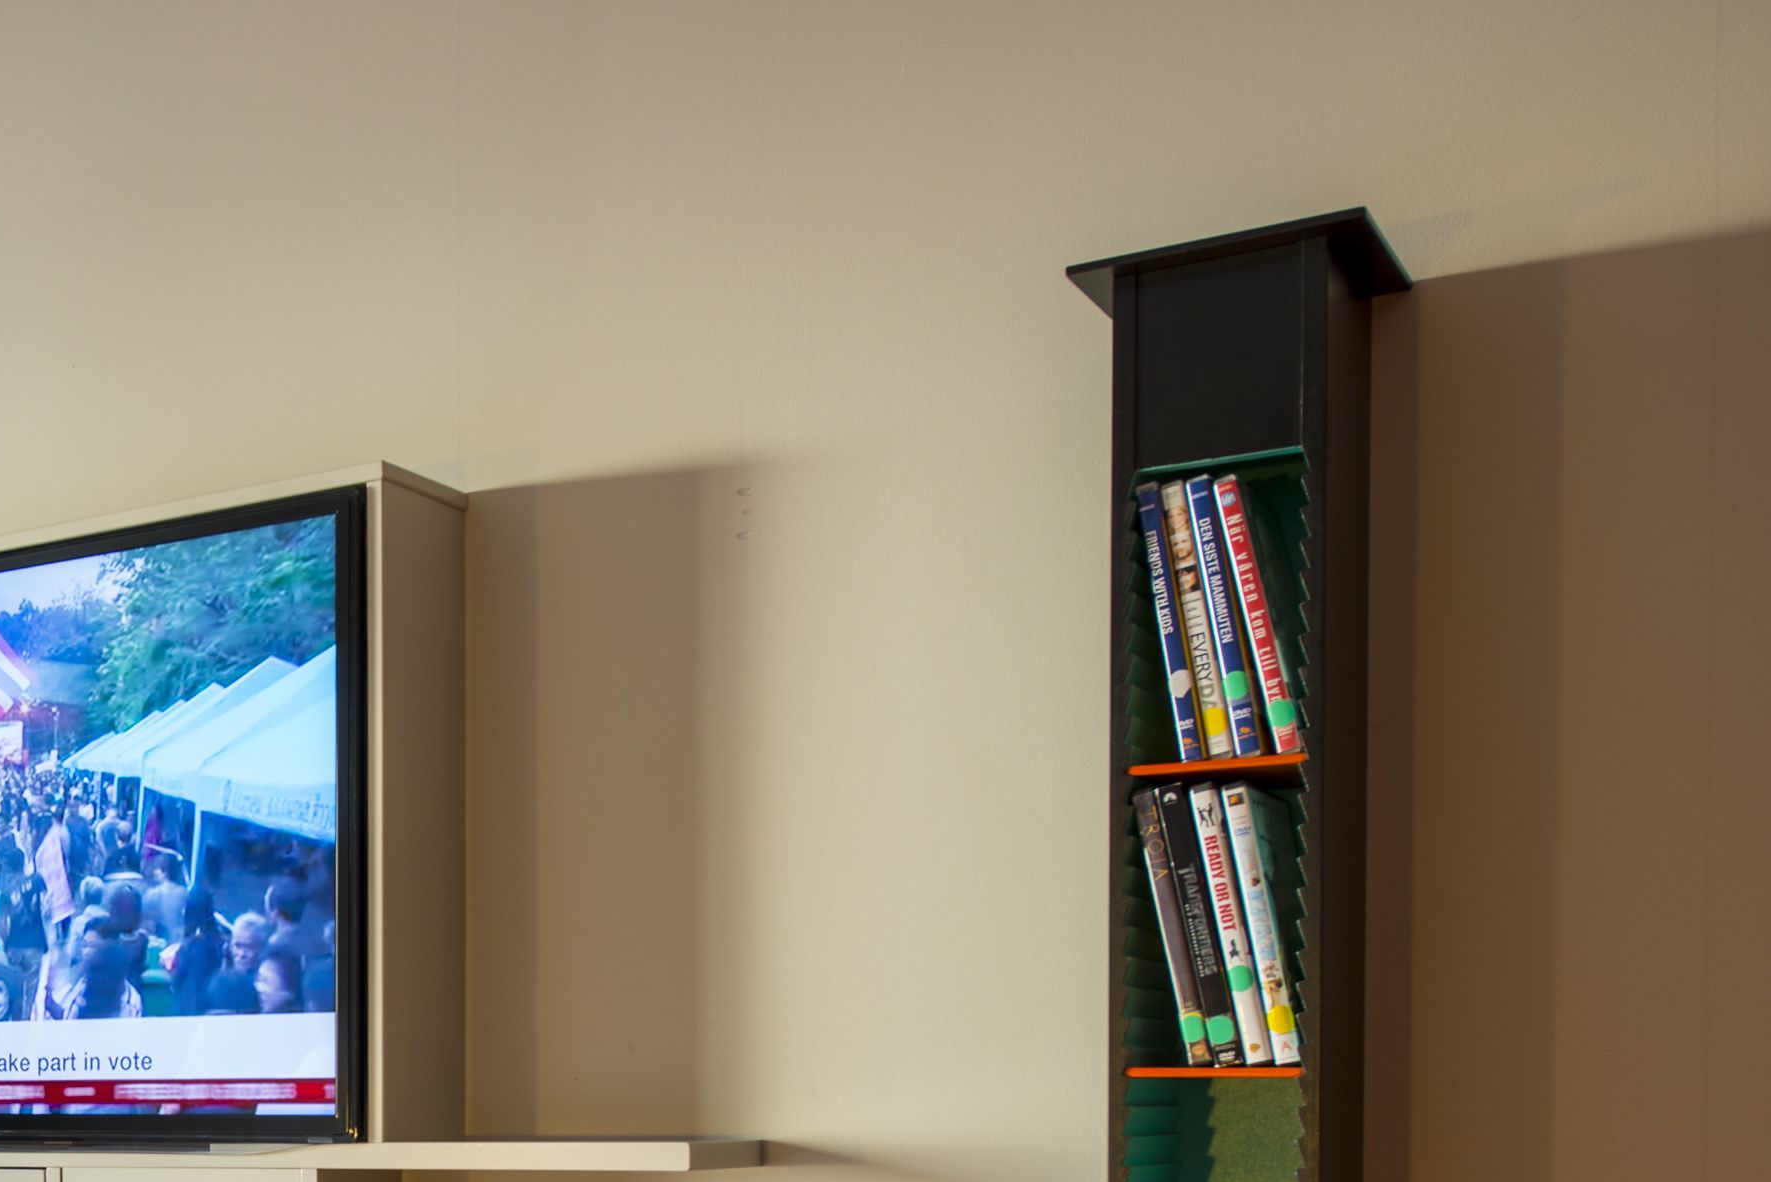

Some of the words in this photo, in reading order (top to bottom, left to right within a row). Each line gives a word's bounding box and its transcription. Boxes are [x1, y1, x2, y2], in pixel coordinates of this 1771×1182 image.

[1198, 517, 1214, 541] DEN
[1226, 513, 1246, 543] När
[1144, 530, 1164, 577] FRIENDS
[1203, 542, 1220, 573] SISTE
[1152, 577, 1169, 606] WITH
[1236, 551, 1259, 603] våren
[1159, 607, 1174, 635] KIDS
[1210, 573, 1234, 644] MAMMUTEN
[1250, 609, 1267, 639] kom
[1258, 646, 1278, 671] till
[1204, 834, 1225, 878] READY
[1214, 882, 1230, 902] OR
[1177, 863, 1218, 976] TRANSFORMERS
[1218, 903, 1237, 931] NOT
[38, 1052, 77, 1076] part
[84, 1051, 101, 1071] in
[108, 1051, 153, 1071] vote
